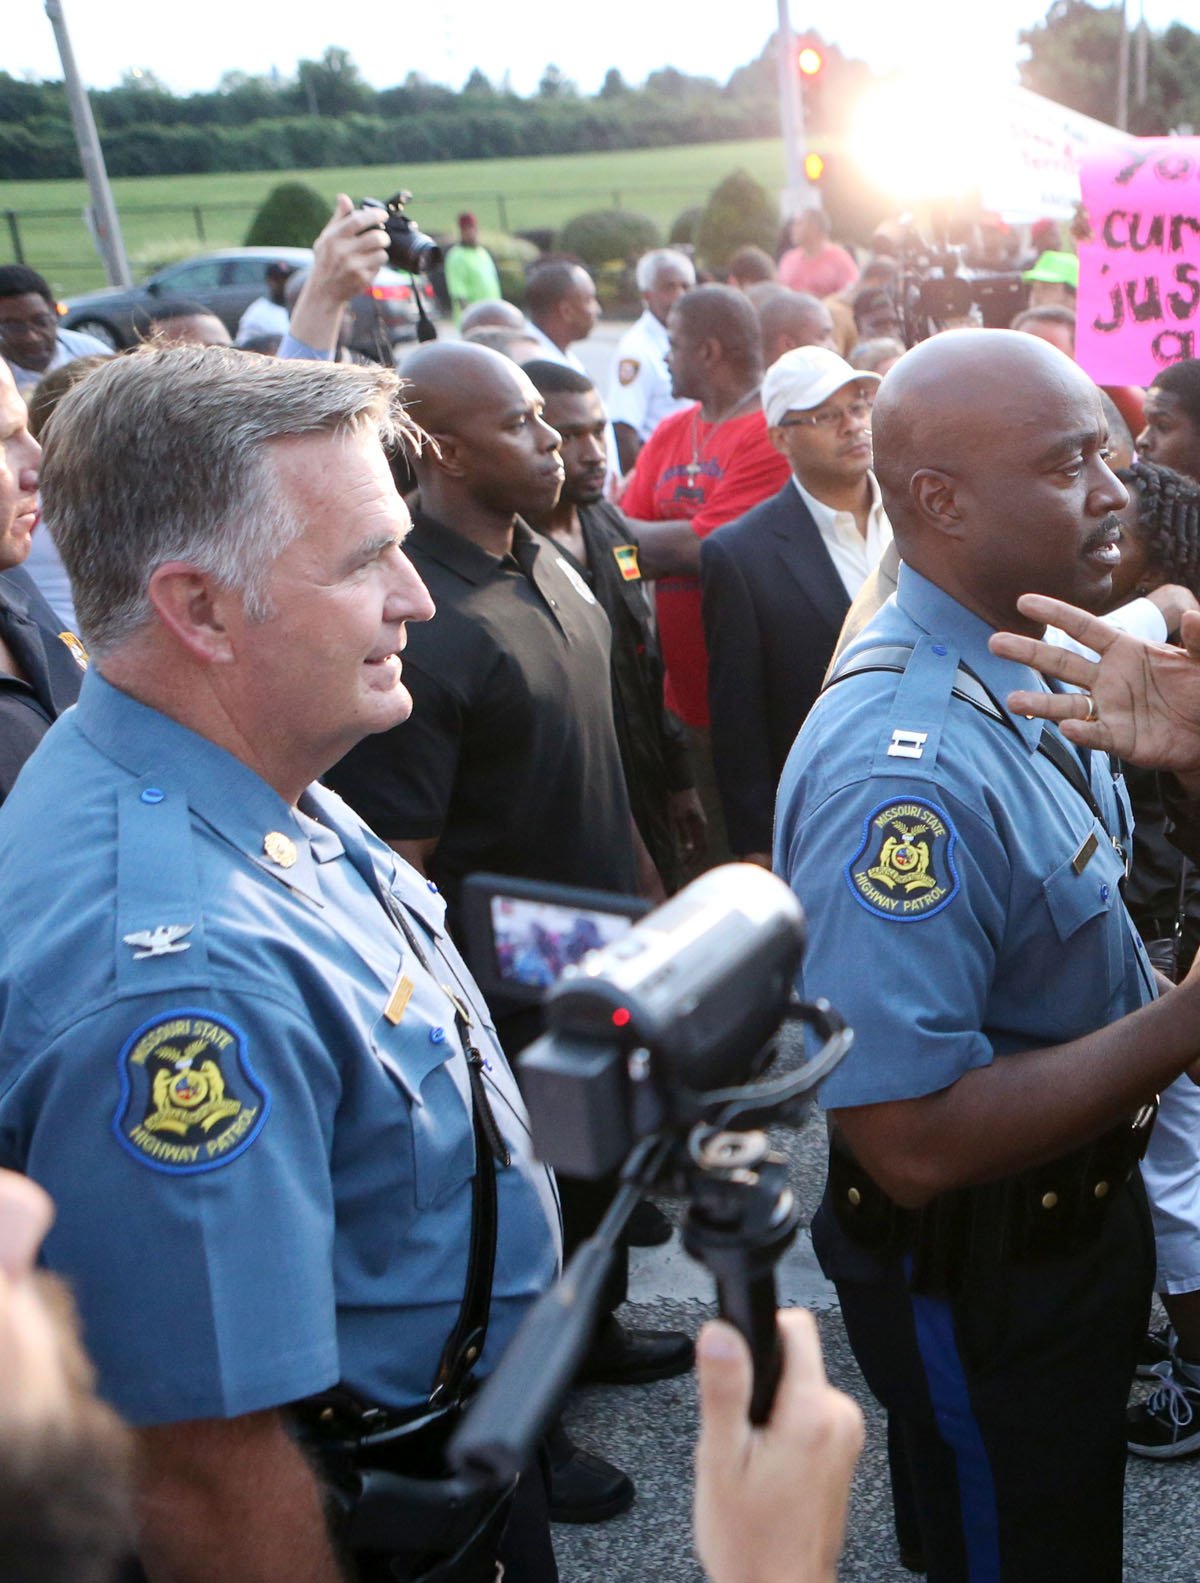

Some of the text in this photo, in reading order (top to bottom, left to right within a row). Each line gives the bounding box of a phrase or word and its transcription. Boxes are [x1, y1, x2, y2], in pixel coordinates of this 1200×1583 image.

[1151, 330, 1195, 365] a
[874, 804, 946, 837] MISSOURI STATE
[854, 870, 900, 911] HIGHWAY
[903, 886, 947, 911] PATROL
[129, 1019, 236, 1066] MISSOURI STATE
[128, 1124, 200, 1164] HIGHWAY
[205, 1105, 258, 1158] PATROL
